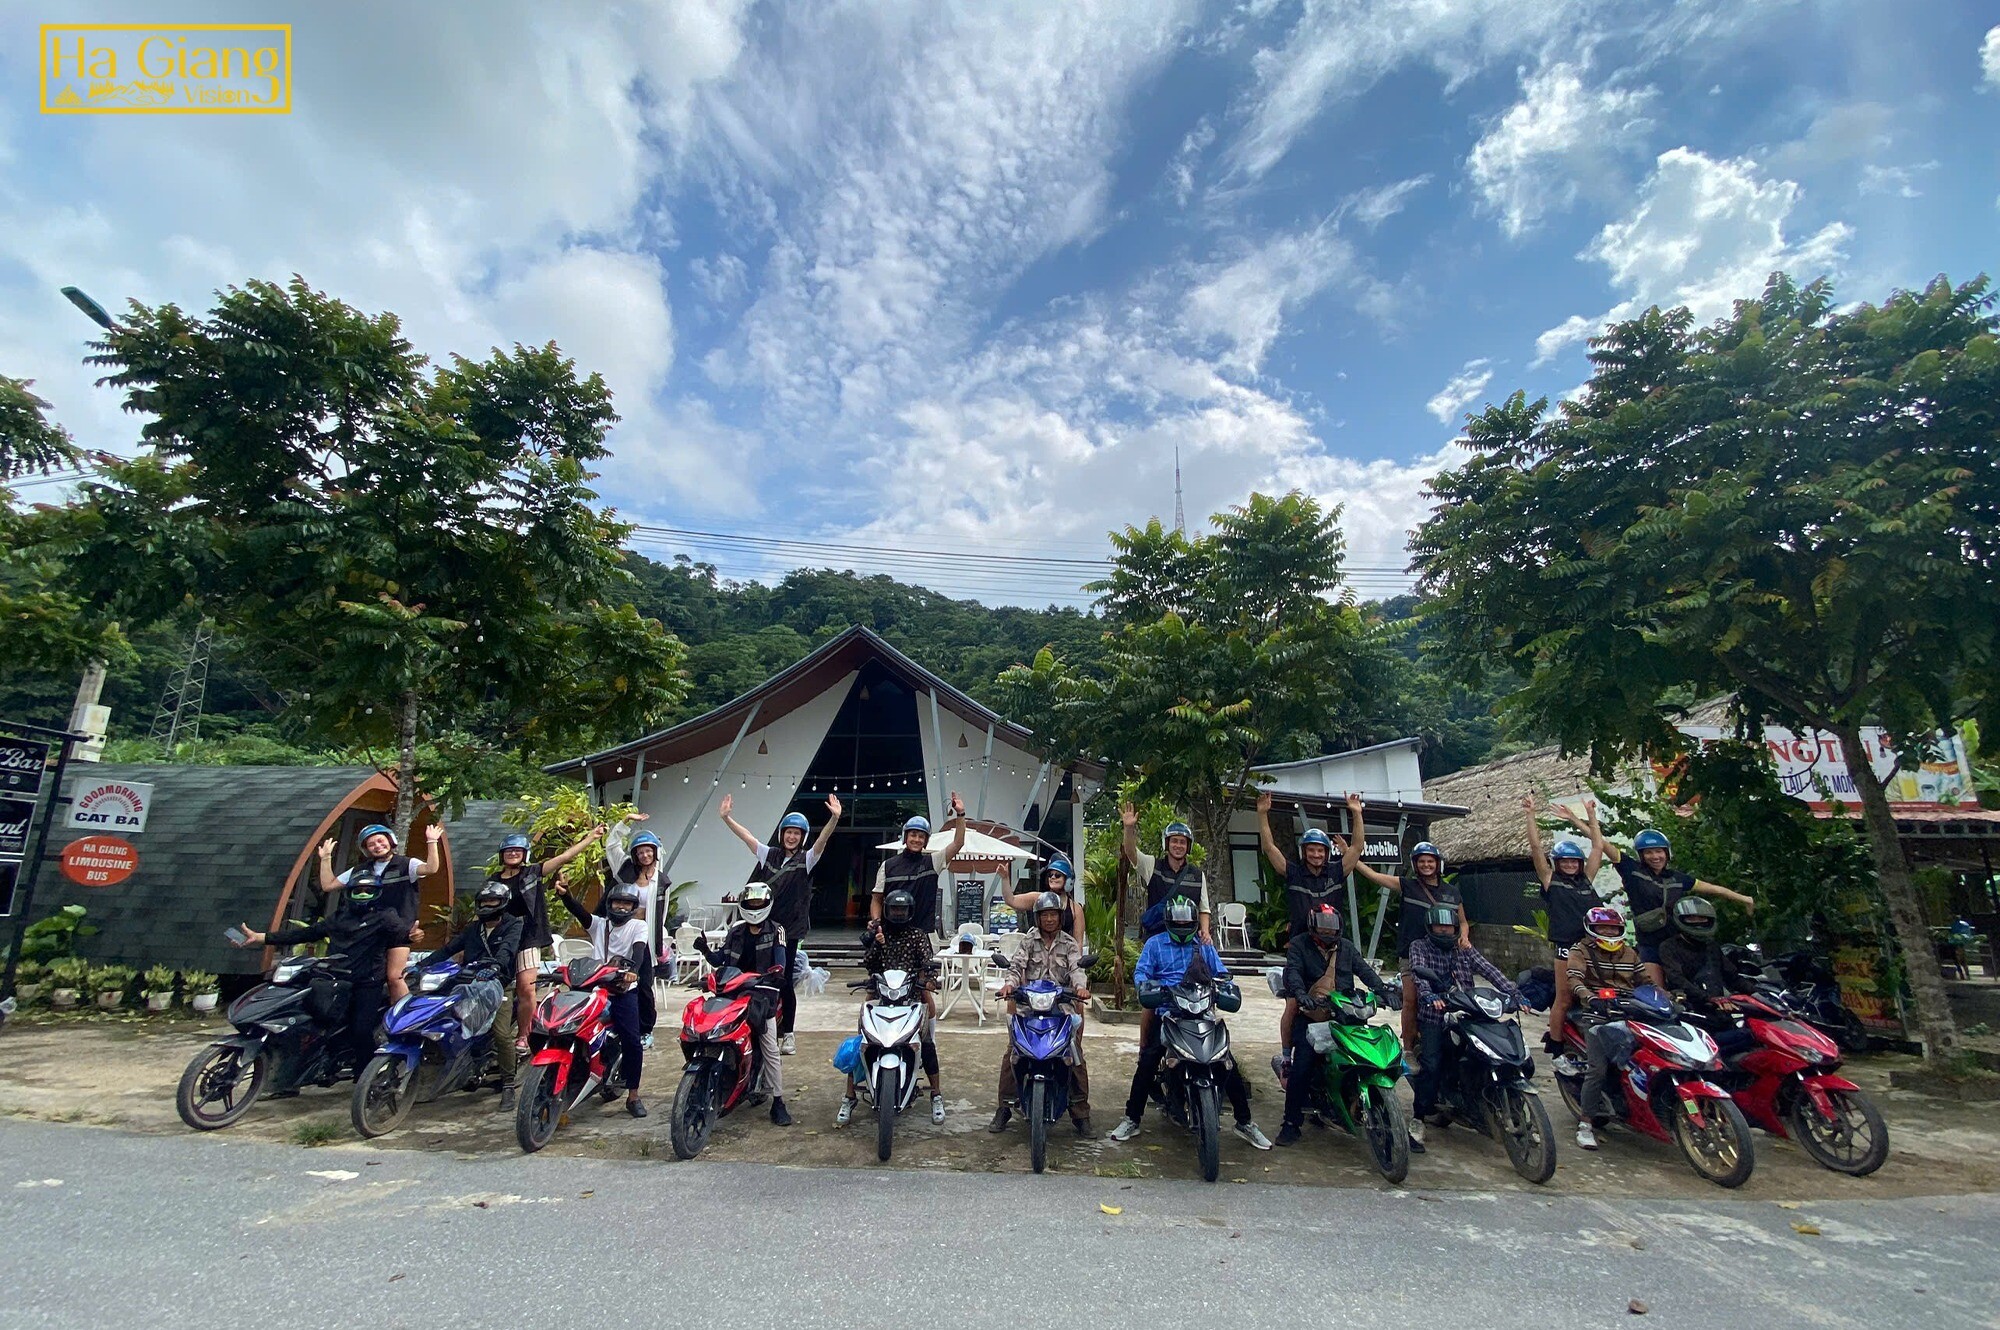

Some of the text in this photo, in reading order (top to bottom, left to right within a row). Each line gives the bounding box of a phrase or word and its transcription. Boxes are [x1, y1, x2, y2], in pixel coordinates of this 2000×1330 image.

[79, 785, 143, 813] GOODMORNING
[75, 812, 139, 825] CAT BA
[83, 843, 128, 856] HA GIANG
[69, 856, 133, 870] LIMOUSINE
[86, 870, 109, 881] BUS
